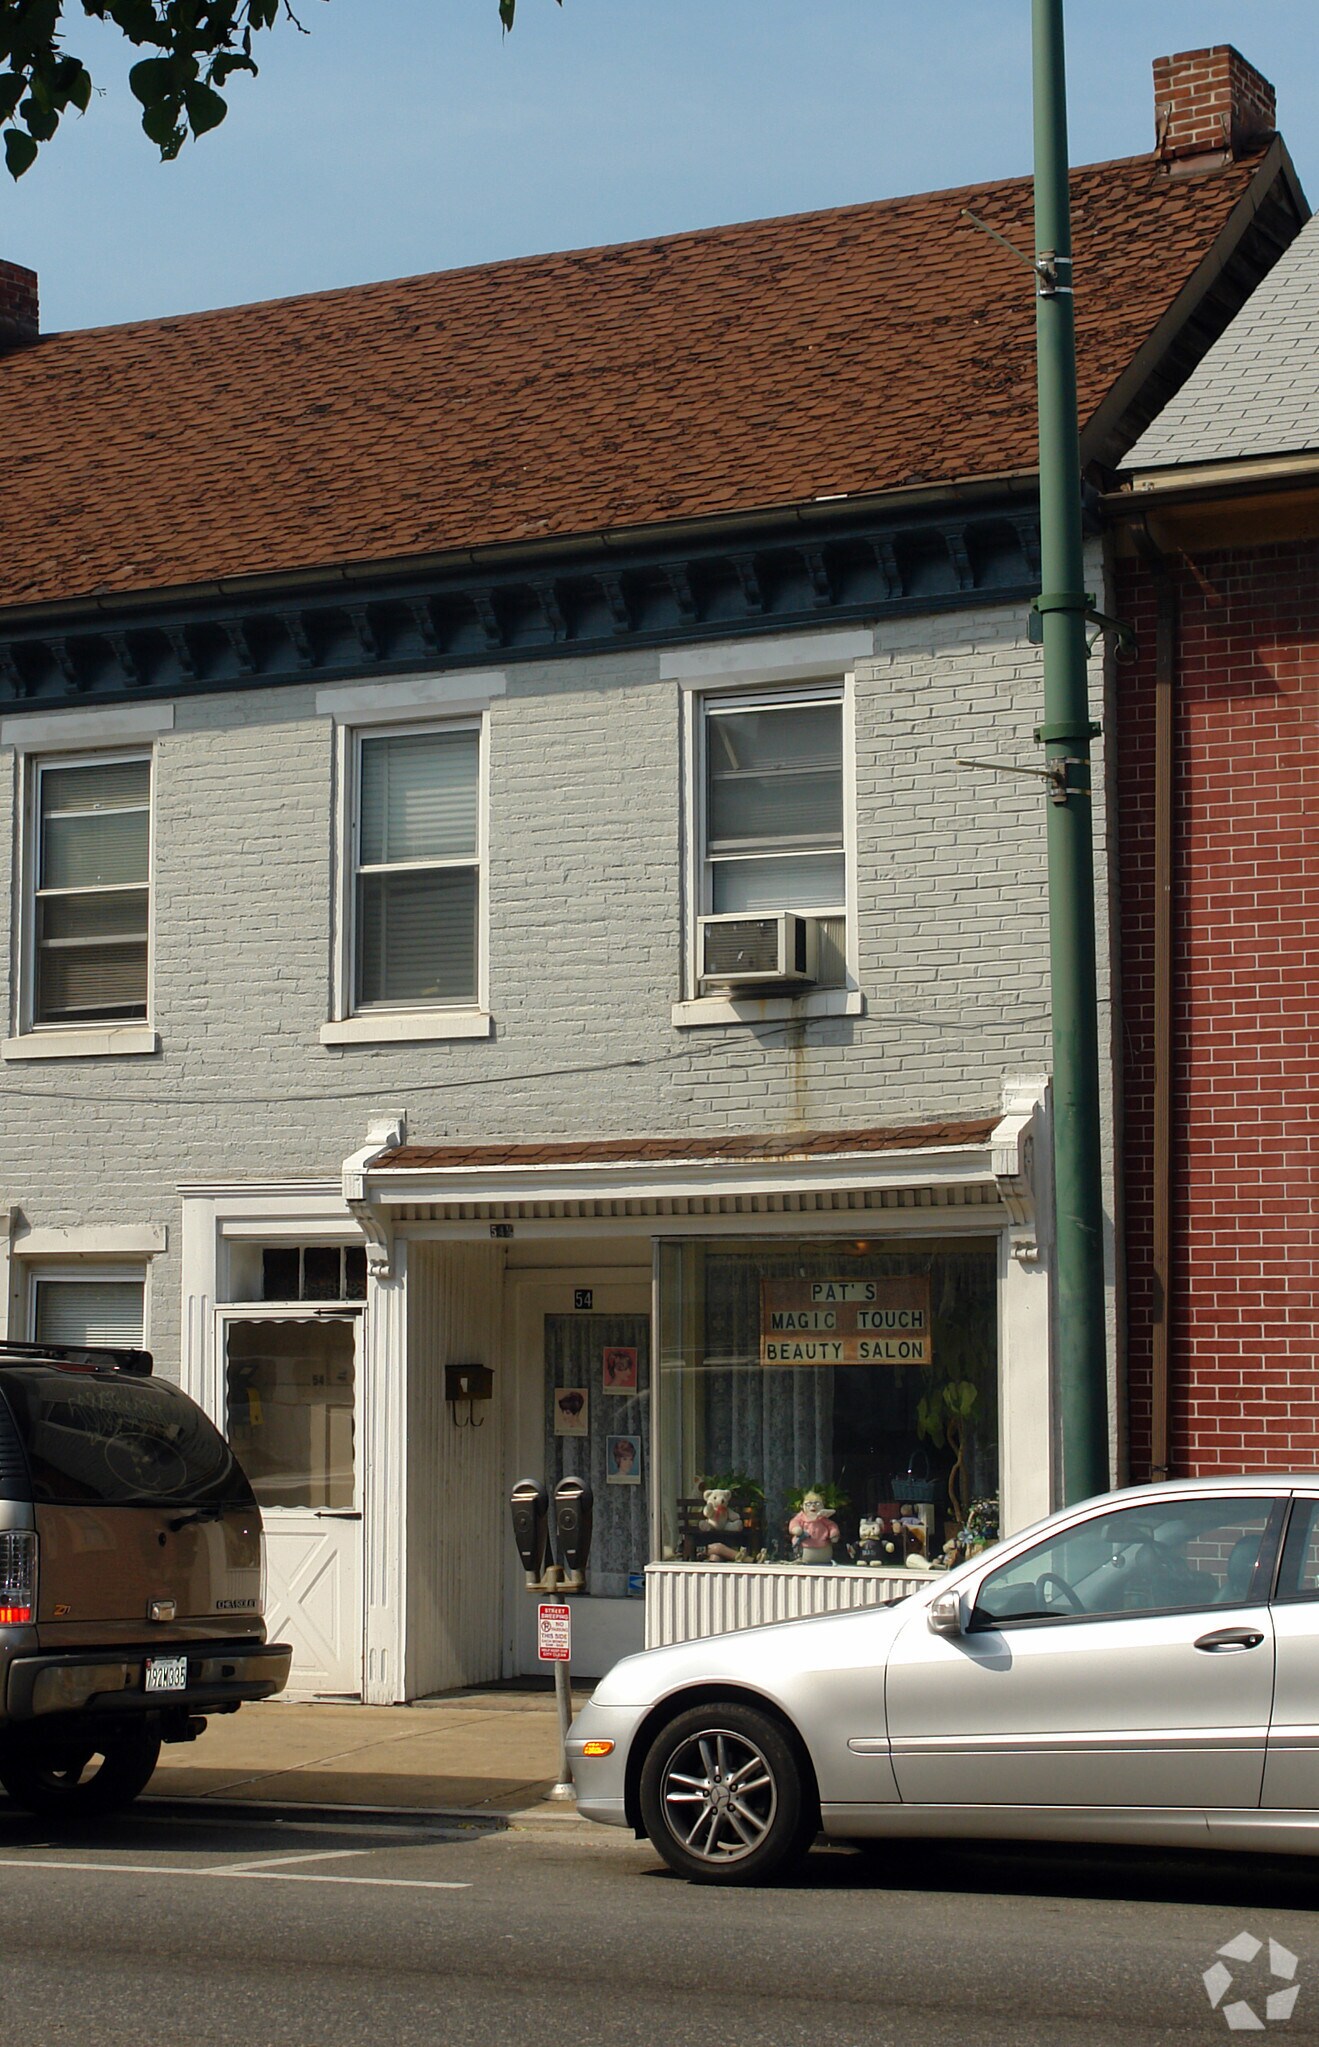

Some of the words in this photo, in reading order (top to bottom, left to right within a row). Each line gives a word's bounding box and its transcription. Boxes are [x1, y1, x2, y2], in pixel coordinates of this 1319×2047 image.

[575, 1292, 592, 1307] 54
[812, 1284, 875, 1300] PAT'S
[772, 1312, 835, 1329] MAGIC
[859, 1311, 923, 1328] TOUCH
[767, 1343, 842, 1360] BEAUTY
[859, 1342, 923, 1358] SALON
[216, 1600, 257, 1609] CHEVROLET
